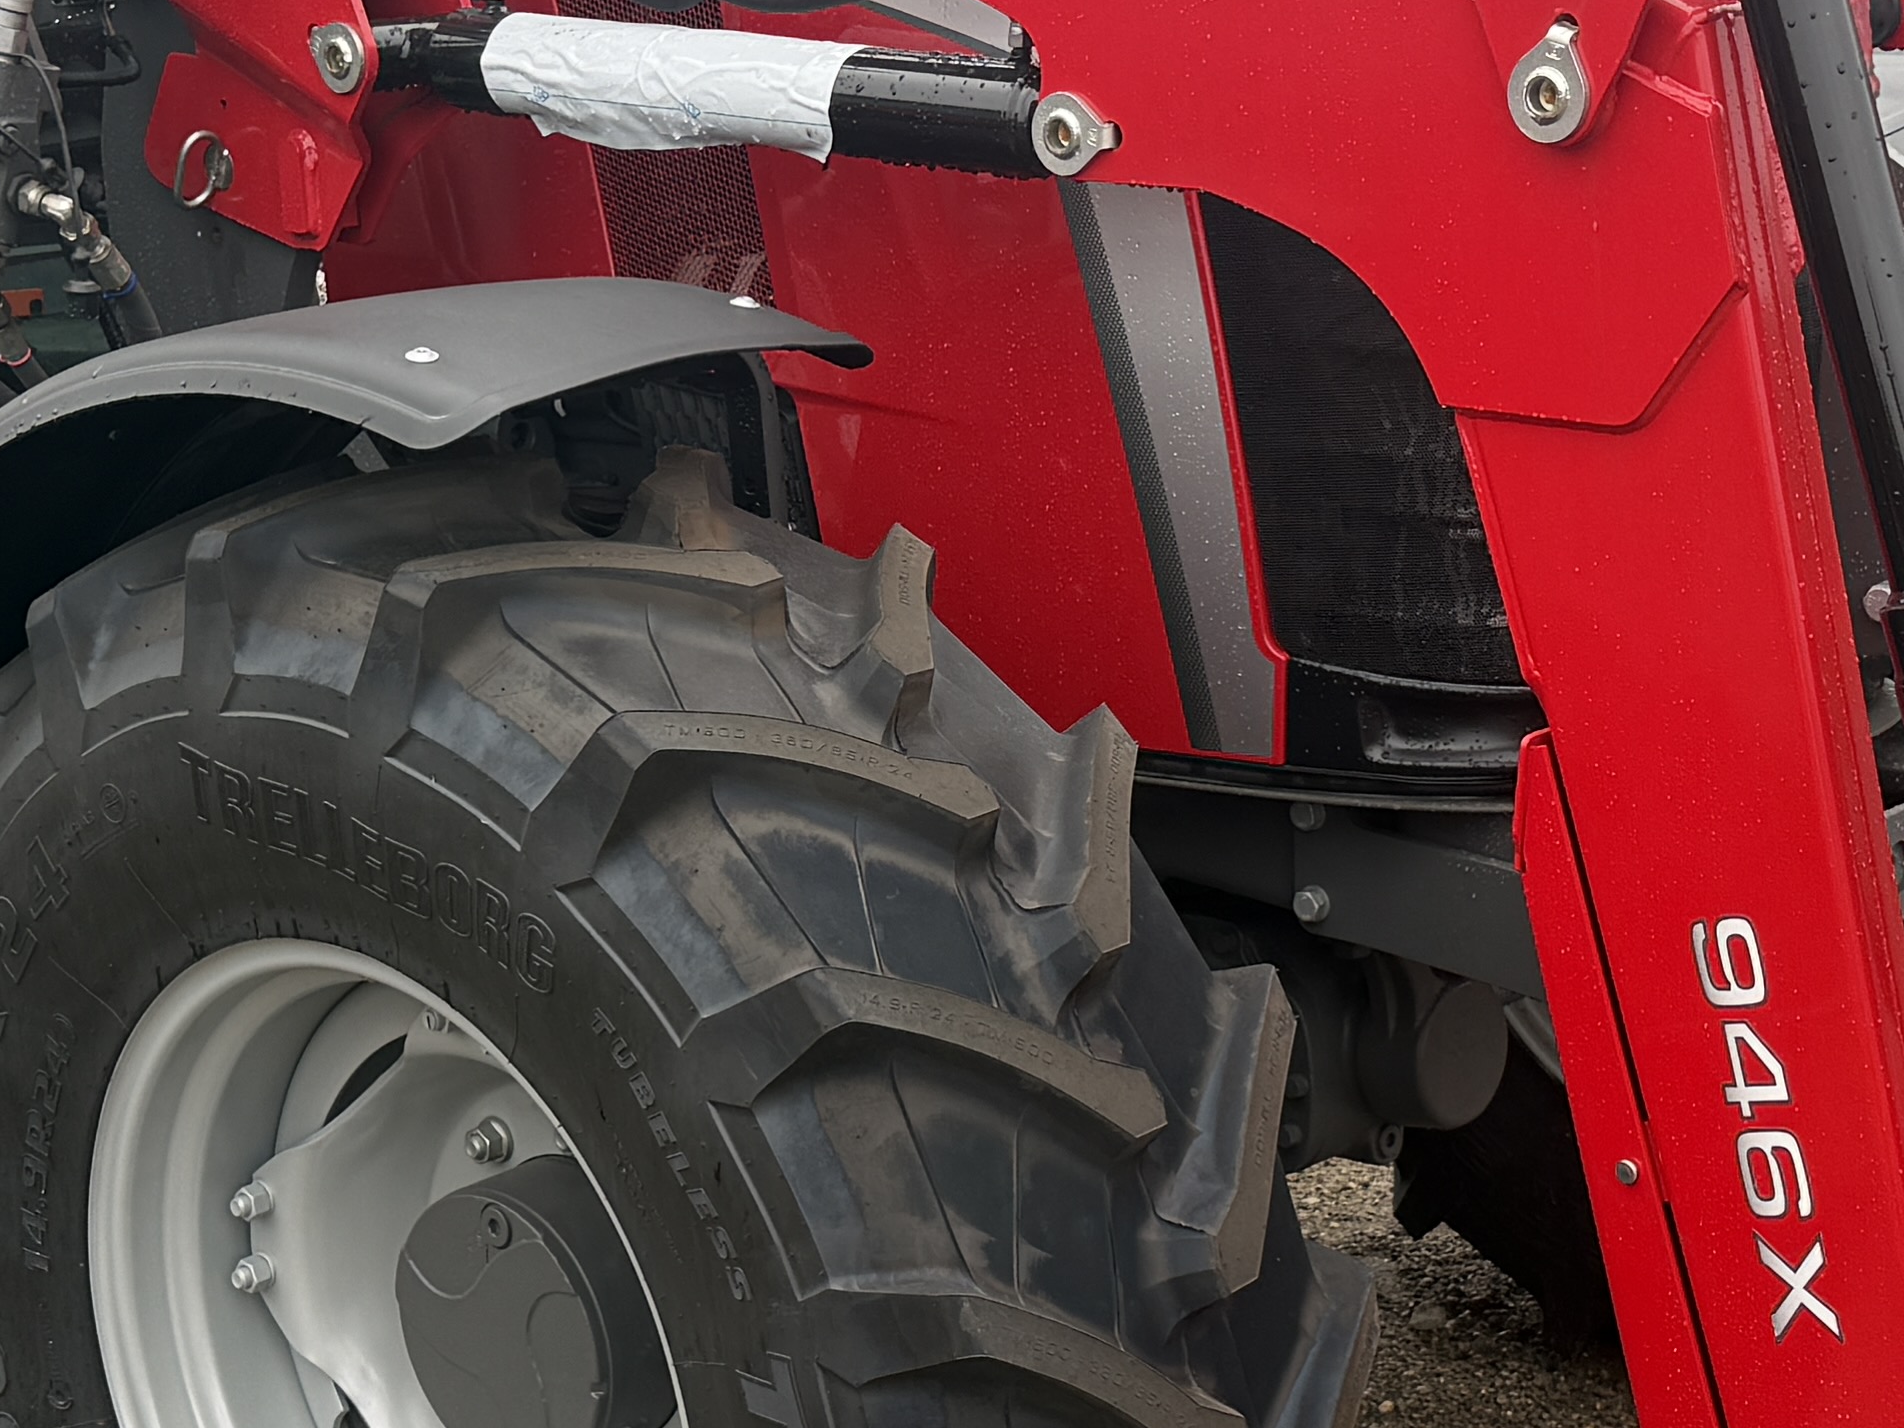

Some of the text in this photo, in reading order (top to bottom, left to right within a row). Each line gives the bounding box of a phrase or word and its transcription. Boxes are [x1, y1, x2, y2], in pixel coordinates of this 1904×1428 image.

[176, 741, 557, 996] TRELLEBORG
[590, 1007, 753, 1302] TUBELESS
[1691, 914, 1845, 1346] 946X
